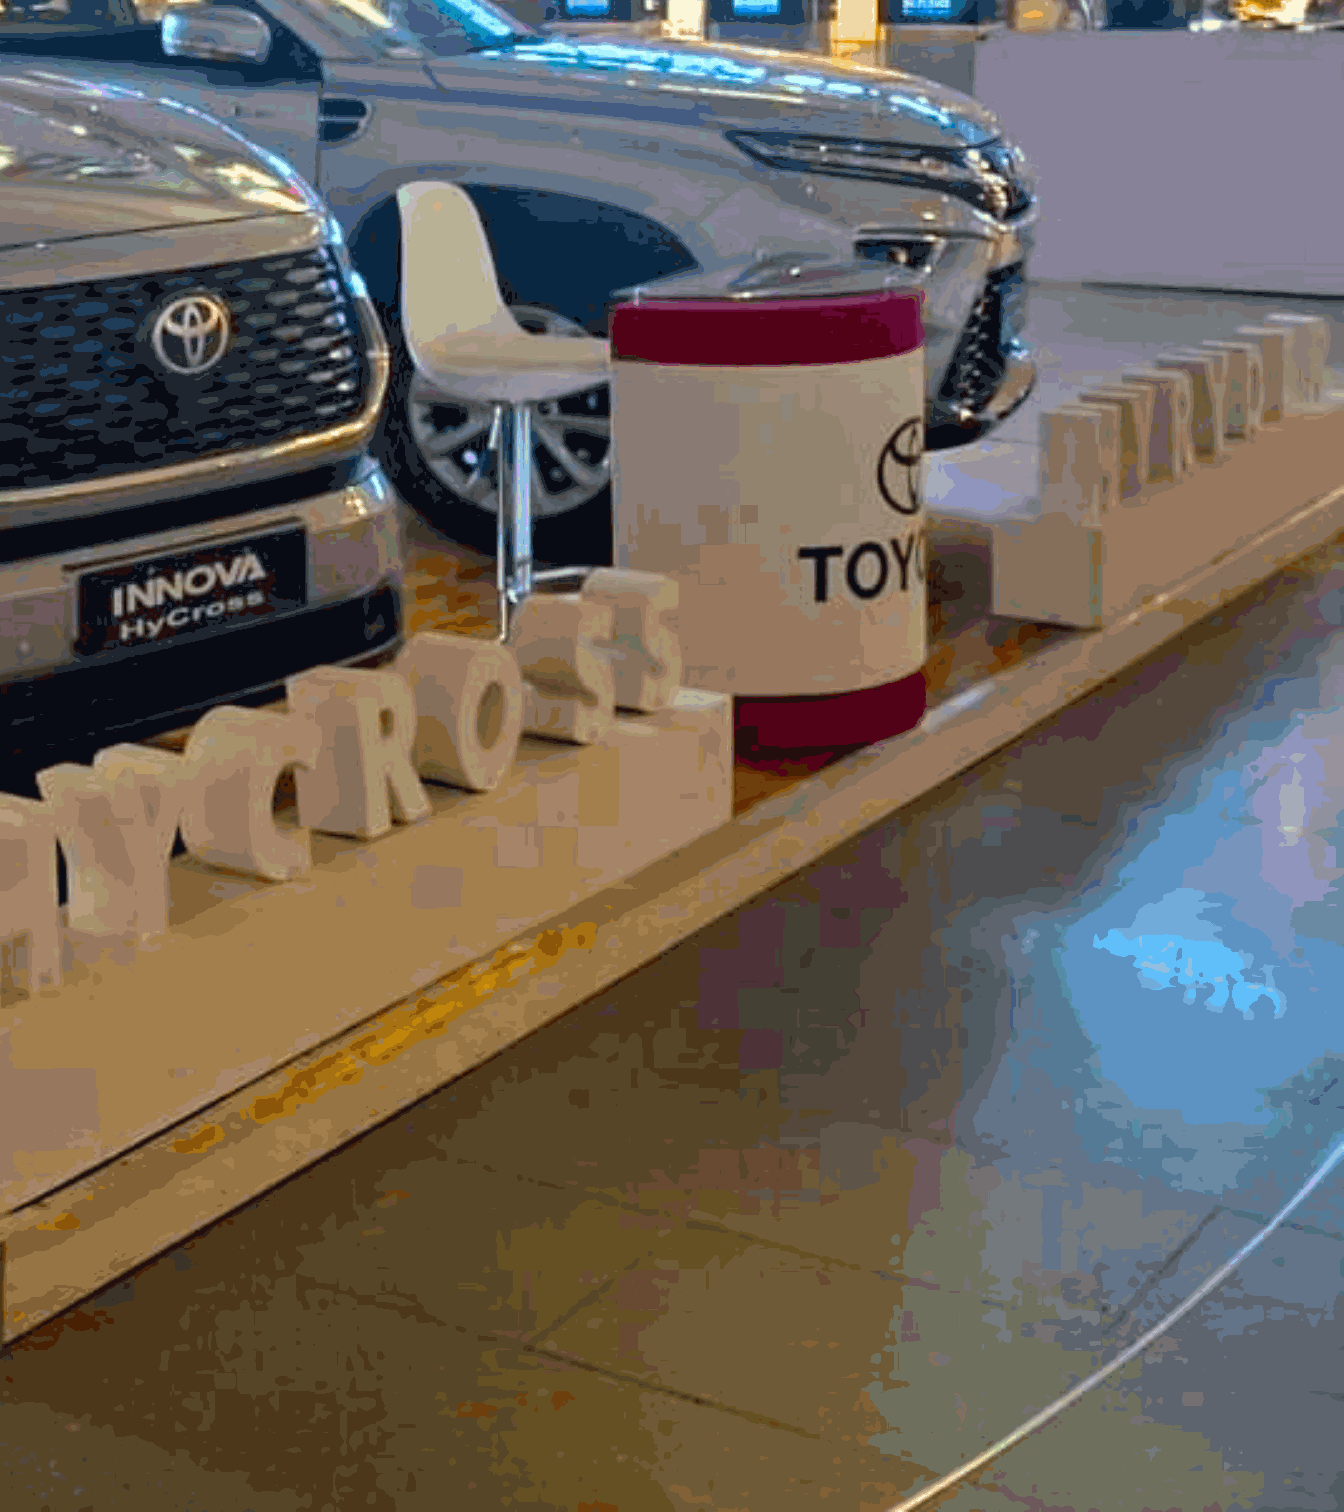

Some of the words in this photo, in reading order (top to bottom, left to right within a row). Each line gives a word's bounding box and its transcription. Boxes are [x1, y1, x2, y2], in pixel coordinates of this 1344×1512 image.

[113, 553, 267, 618] INNOVA
[797, 534, 925, 603] TOY
[120, 591, 265, 641] HyCross
